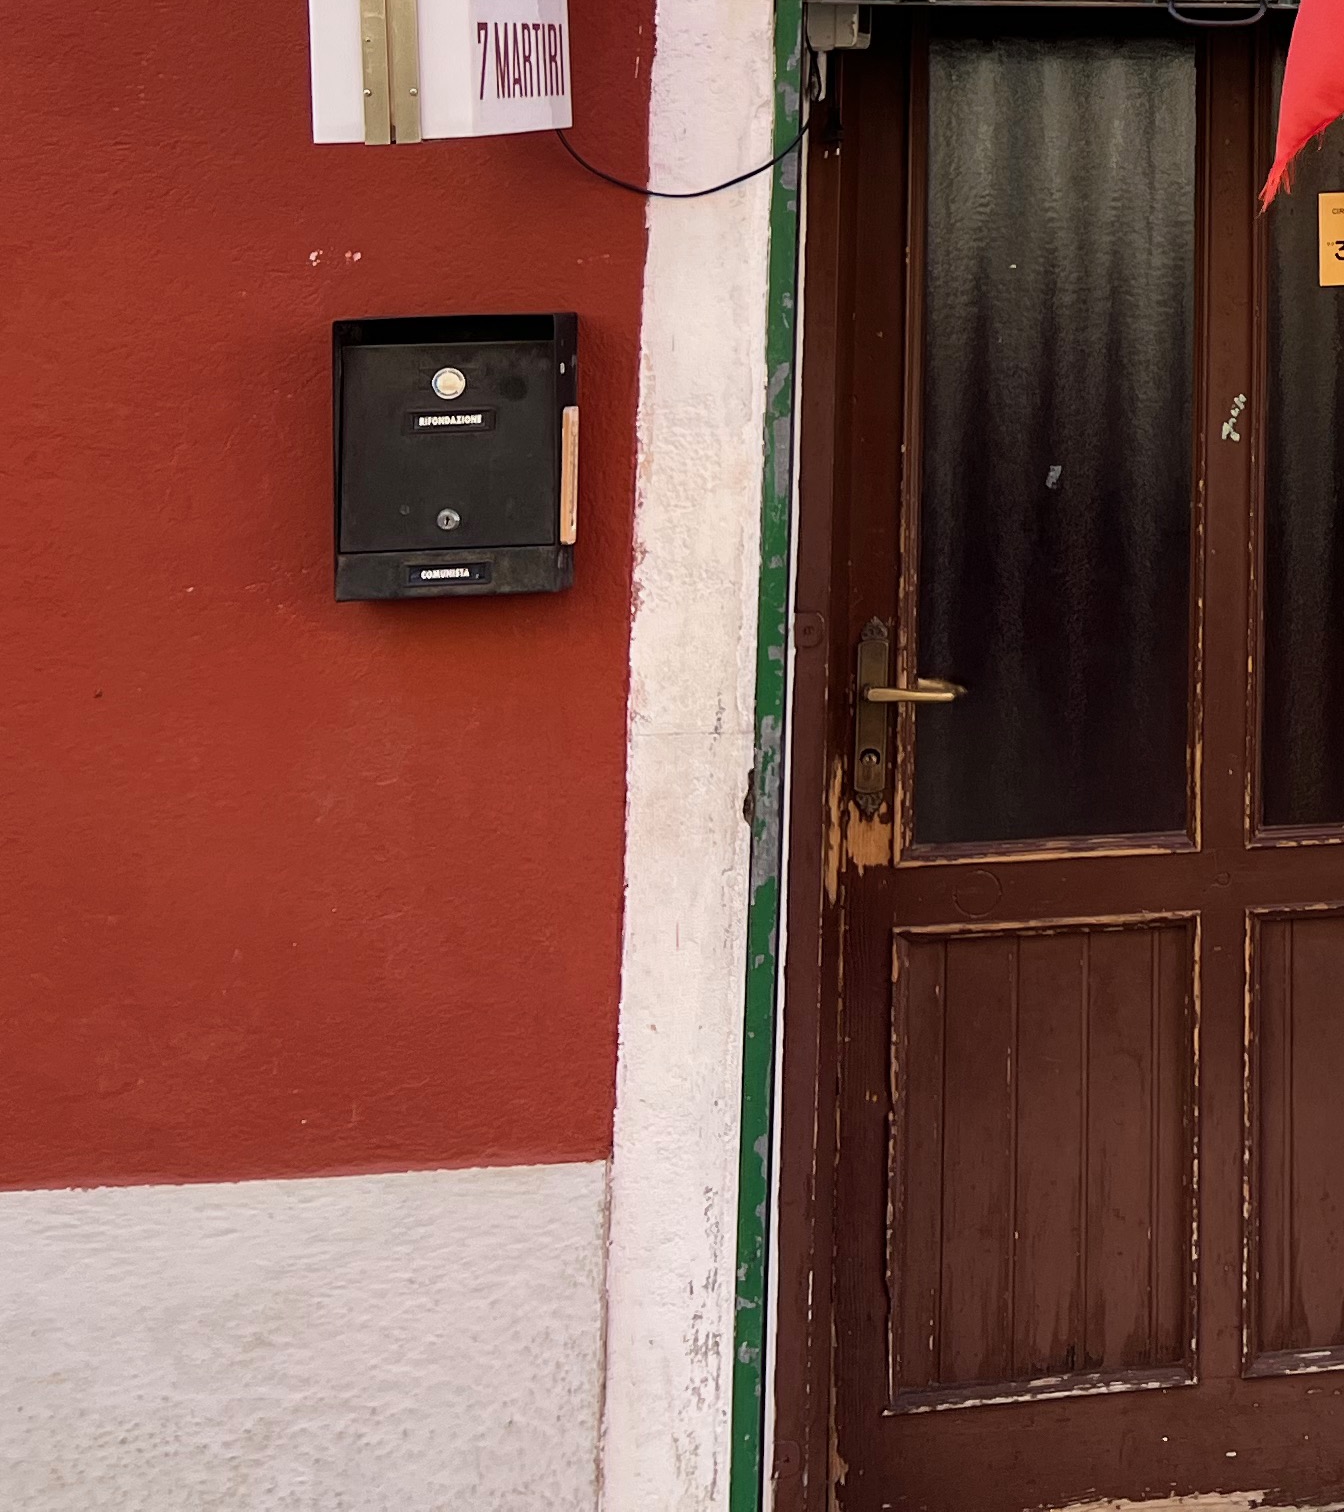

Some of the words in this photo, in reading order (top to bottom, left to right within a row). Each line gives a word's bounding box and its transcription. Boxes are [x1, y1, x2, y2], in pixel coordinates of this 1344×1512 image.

[477, 21, 489, 100] 7
[494, 21, 565, 99] MARTIRI
[418, 414, 482, 427] RIFONDAZIONE
[420, 567, 470, 580] COMUNISTA
